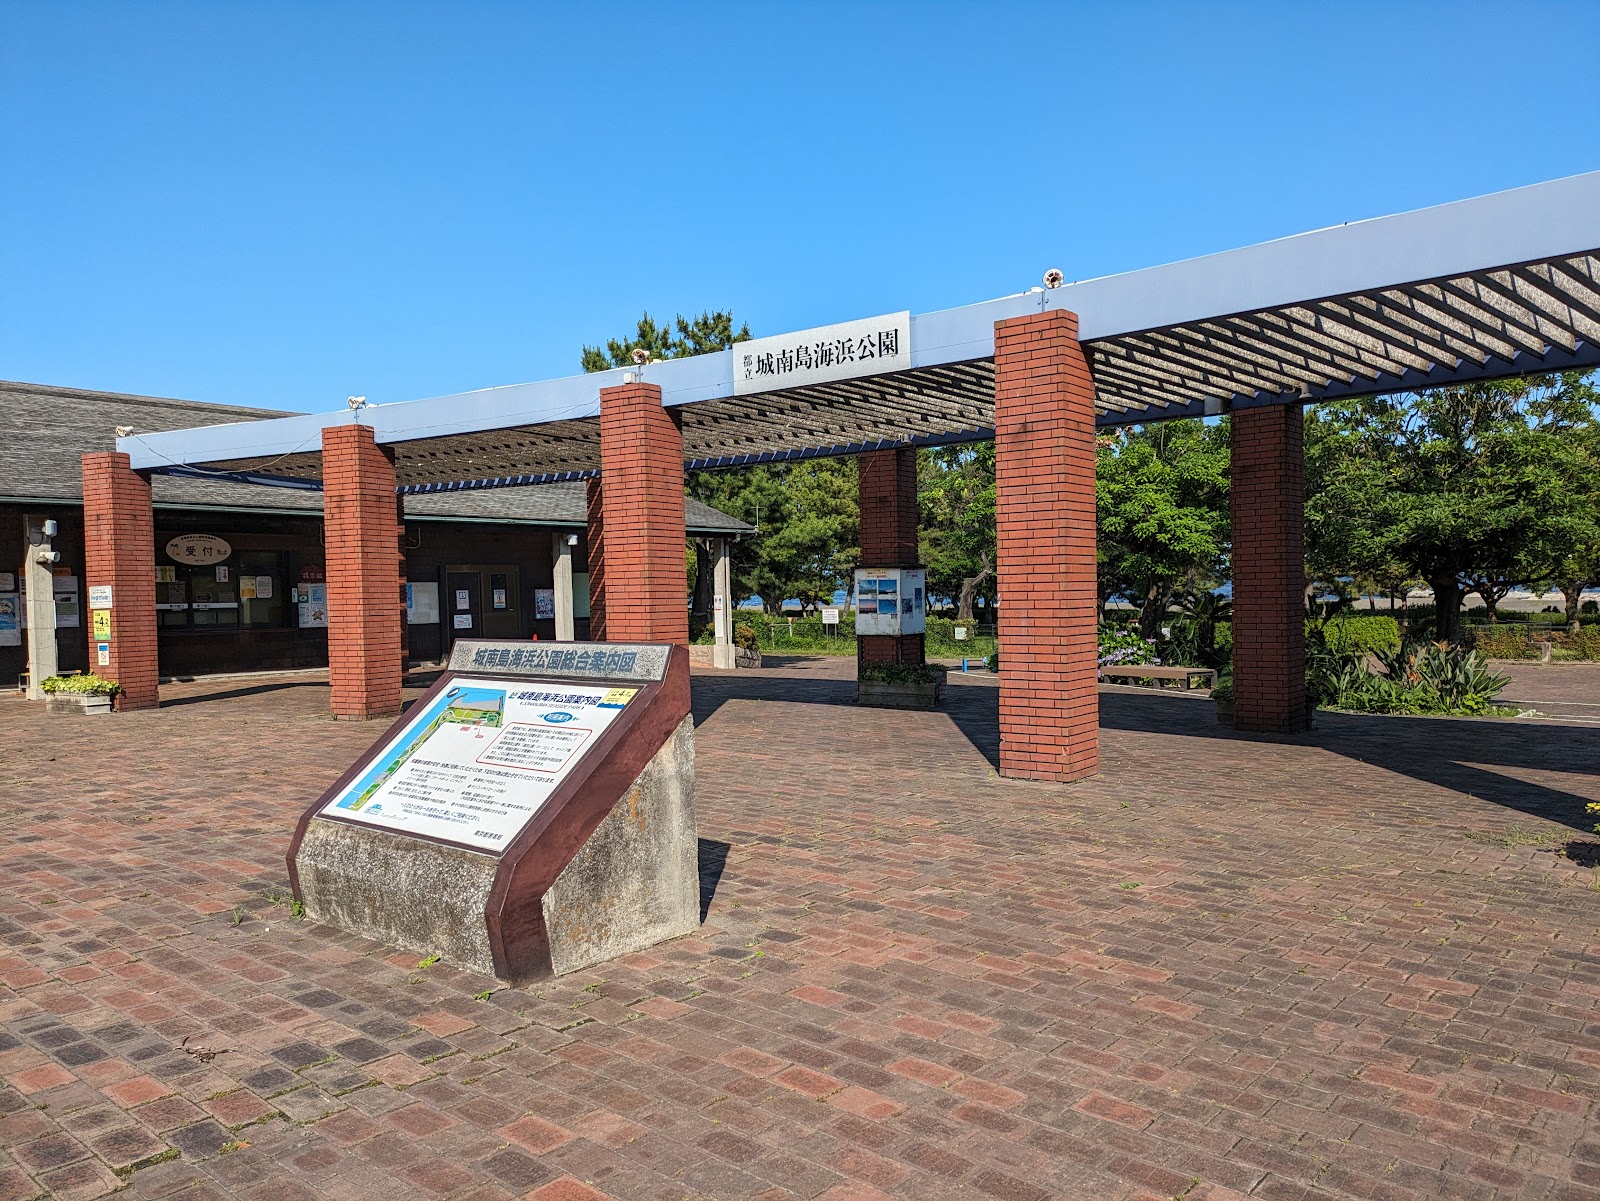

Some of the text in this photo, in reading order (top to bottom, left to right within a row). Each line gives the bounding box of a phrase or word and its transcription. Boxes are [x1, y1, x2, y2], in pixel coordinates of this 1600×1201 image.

[755, 328, 899, 377] 城南島海浜公園
[185, 545, 214, 557] 受付
[472, 647, 638, 674] 城南島海浜公園総合案内図
[517, 690, 603, 706] 城南島海浜公園案内図
